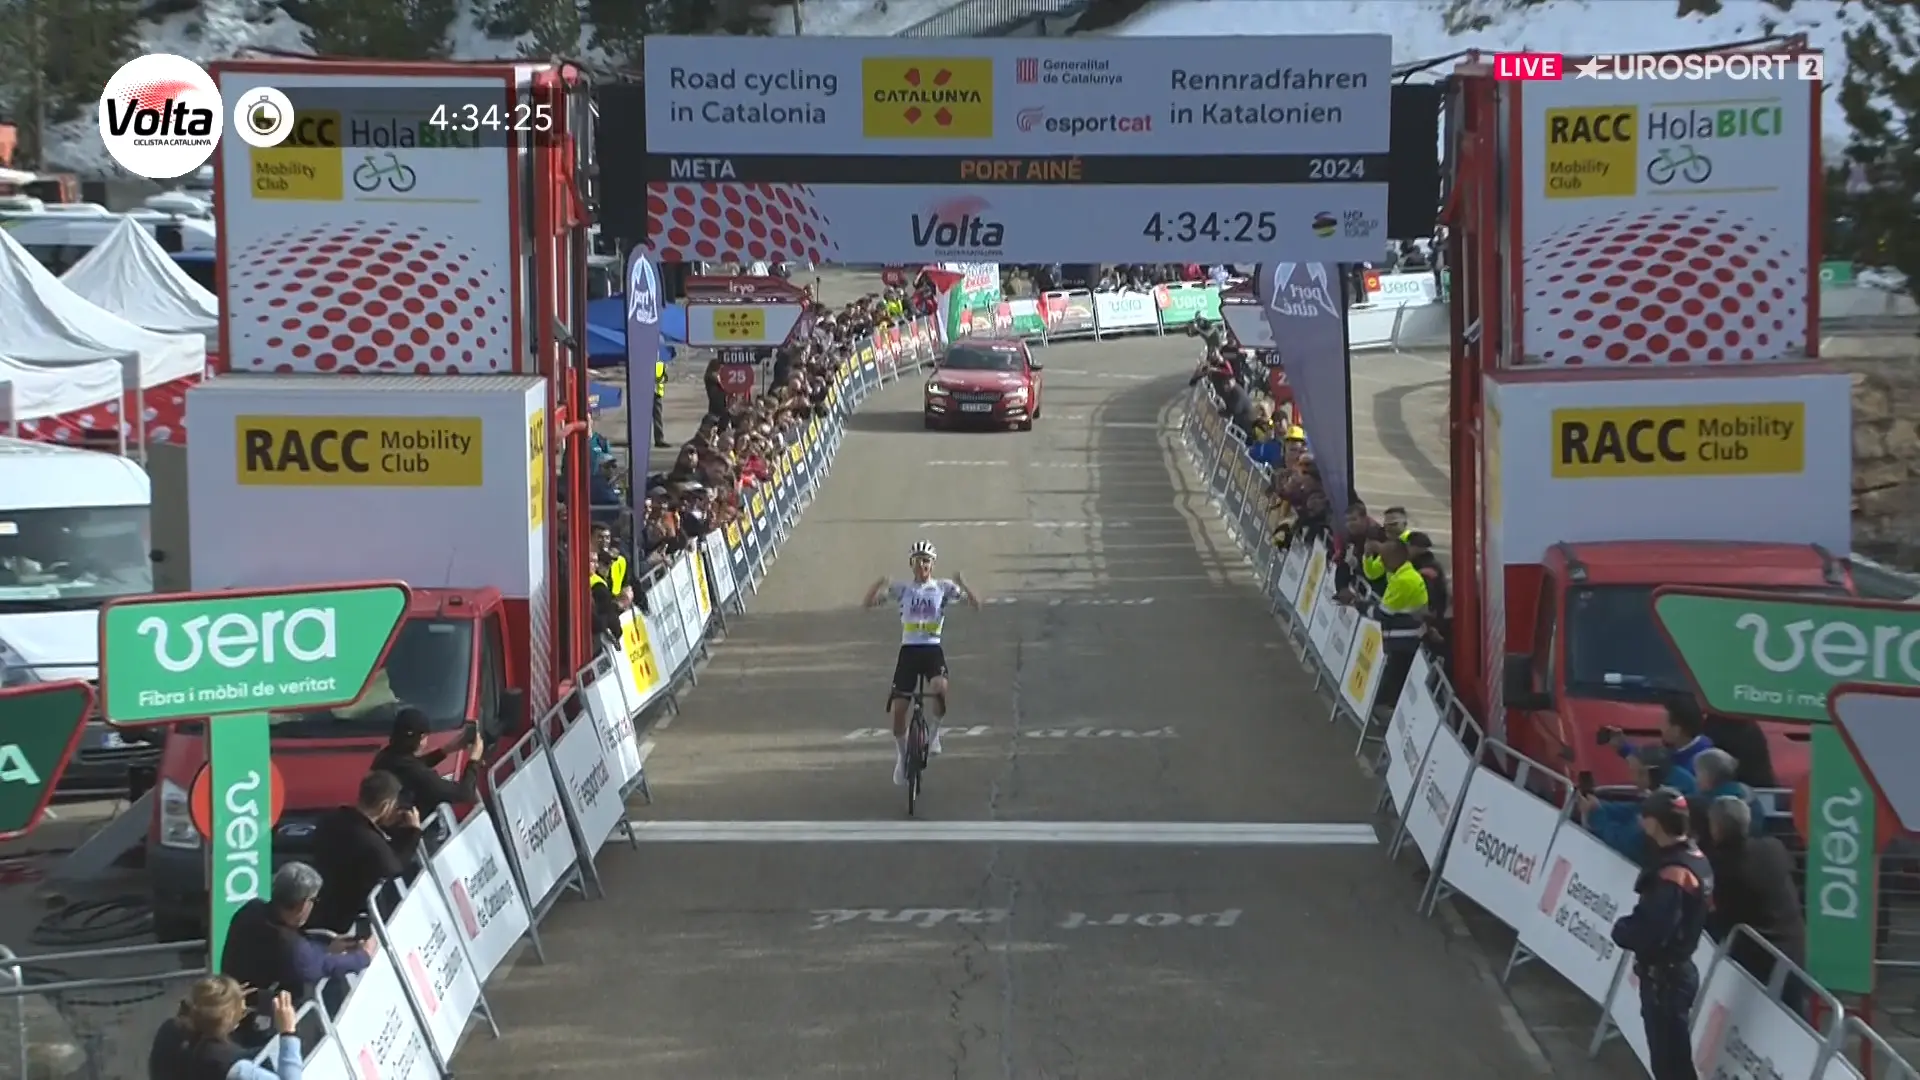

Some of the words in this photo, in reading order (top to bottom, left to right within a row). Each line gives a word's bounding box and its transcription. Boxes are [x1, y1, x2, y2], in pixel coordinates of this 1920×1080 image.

[1043, 60, 1109, 70] Generalitat
[671, 68, 736, 89] Road
[744, 68, 838, 95] cycling
[1043, 74, 1058, 84] de
[1062, 73, 1123, 85] Catalunya
[1171, 68, 1367, 90] Rennradfahren
[873, 89, 983, 103] CATALUNYA
[671, 103, 694, 122] in
[702, 102, 826, 124] Catalonia
[1170, 103, 1192, 124] in
[1203, 102, 1342, 125] Katalonien
[1647, 107, 1782, 140] HolaBICI
[1045, 114, 1152, 137] esportcat
[1550, 113, 1632, 143] RACC
[256, 162, 316, 179] Mobility
[671, 159, 736, 178] META
[961, 160, 1022, 180] PORT
[1027, 155, 1082, 180] AINÉ
[1309, 159, 1365, 179] 2024
[1550, 159, 1610, 177] Mobility
[257, 178, 288, 191] Club
[1550, 175, 1581, 190] Club
[911, 213, 1004, 247] Volta
[1143, 212, 1277, 242] 4:34:25
[1698, 416, 1794, 440] Mobility
[245, 429, 370, 473] RACC
[381, 430, 472, 454] Mobility
[1561, 419, 1687, 464] RACC
[1698, 441, 1749, 461] Club
[381, 453, 430, 473] Club
[137, 607, 336, 672] vera
[139, 690, 185, 706] Fibra
[189, 688, 194, 702] i
[198, 683, 248, 701] mòbil
[252, 681, 274, 697] de
[279, 677, 336, 694] veritat
[1733, 684, 1782, 704] Fibra
[225, 770, 260, 902] vera
[1475, 829, 1537, 885] esportcat
[1820, 787, 1862, 919] vera
